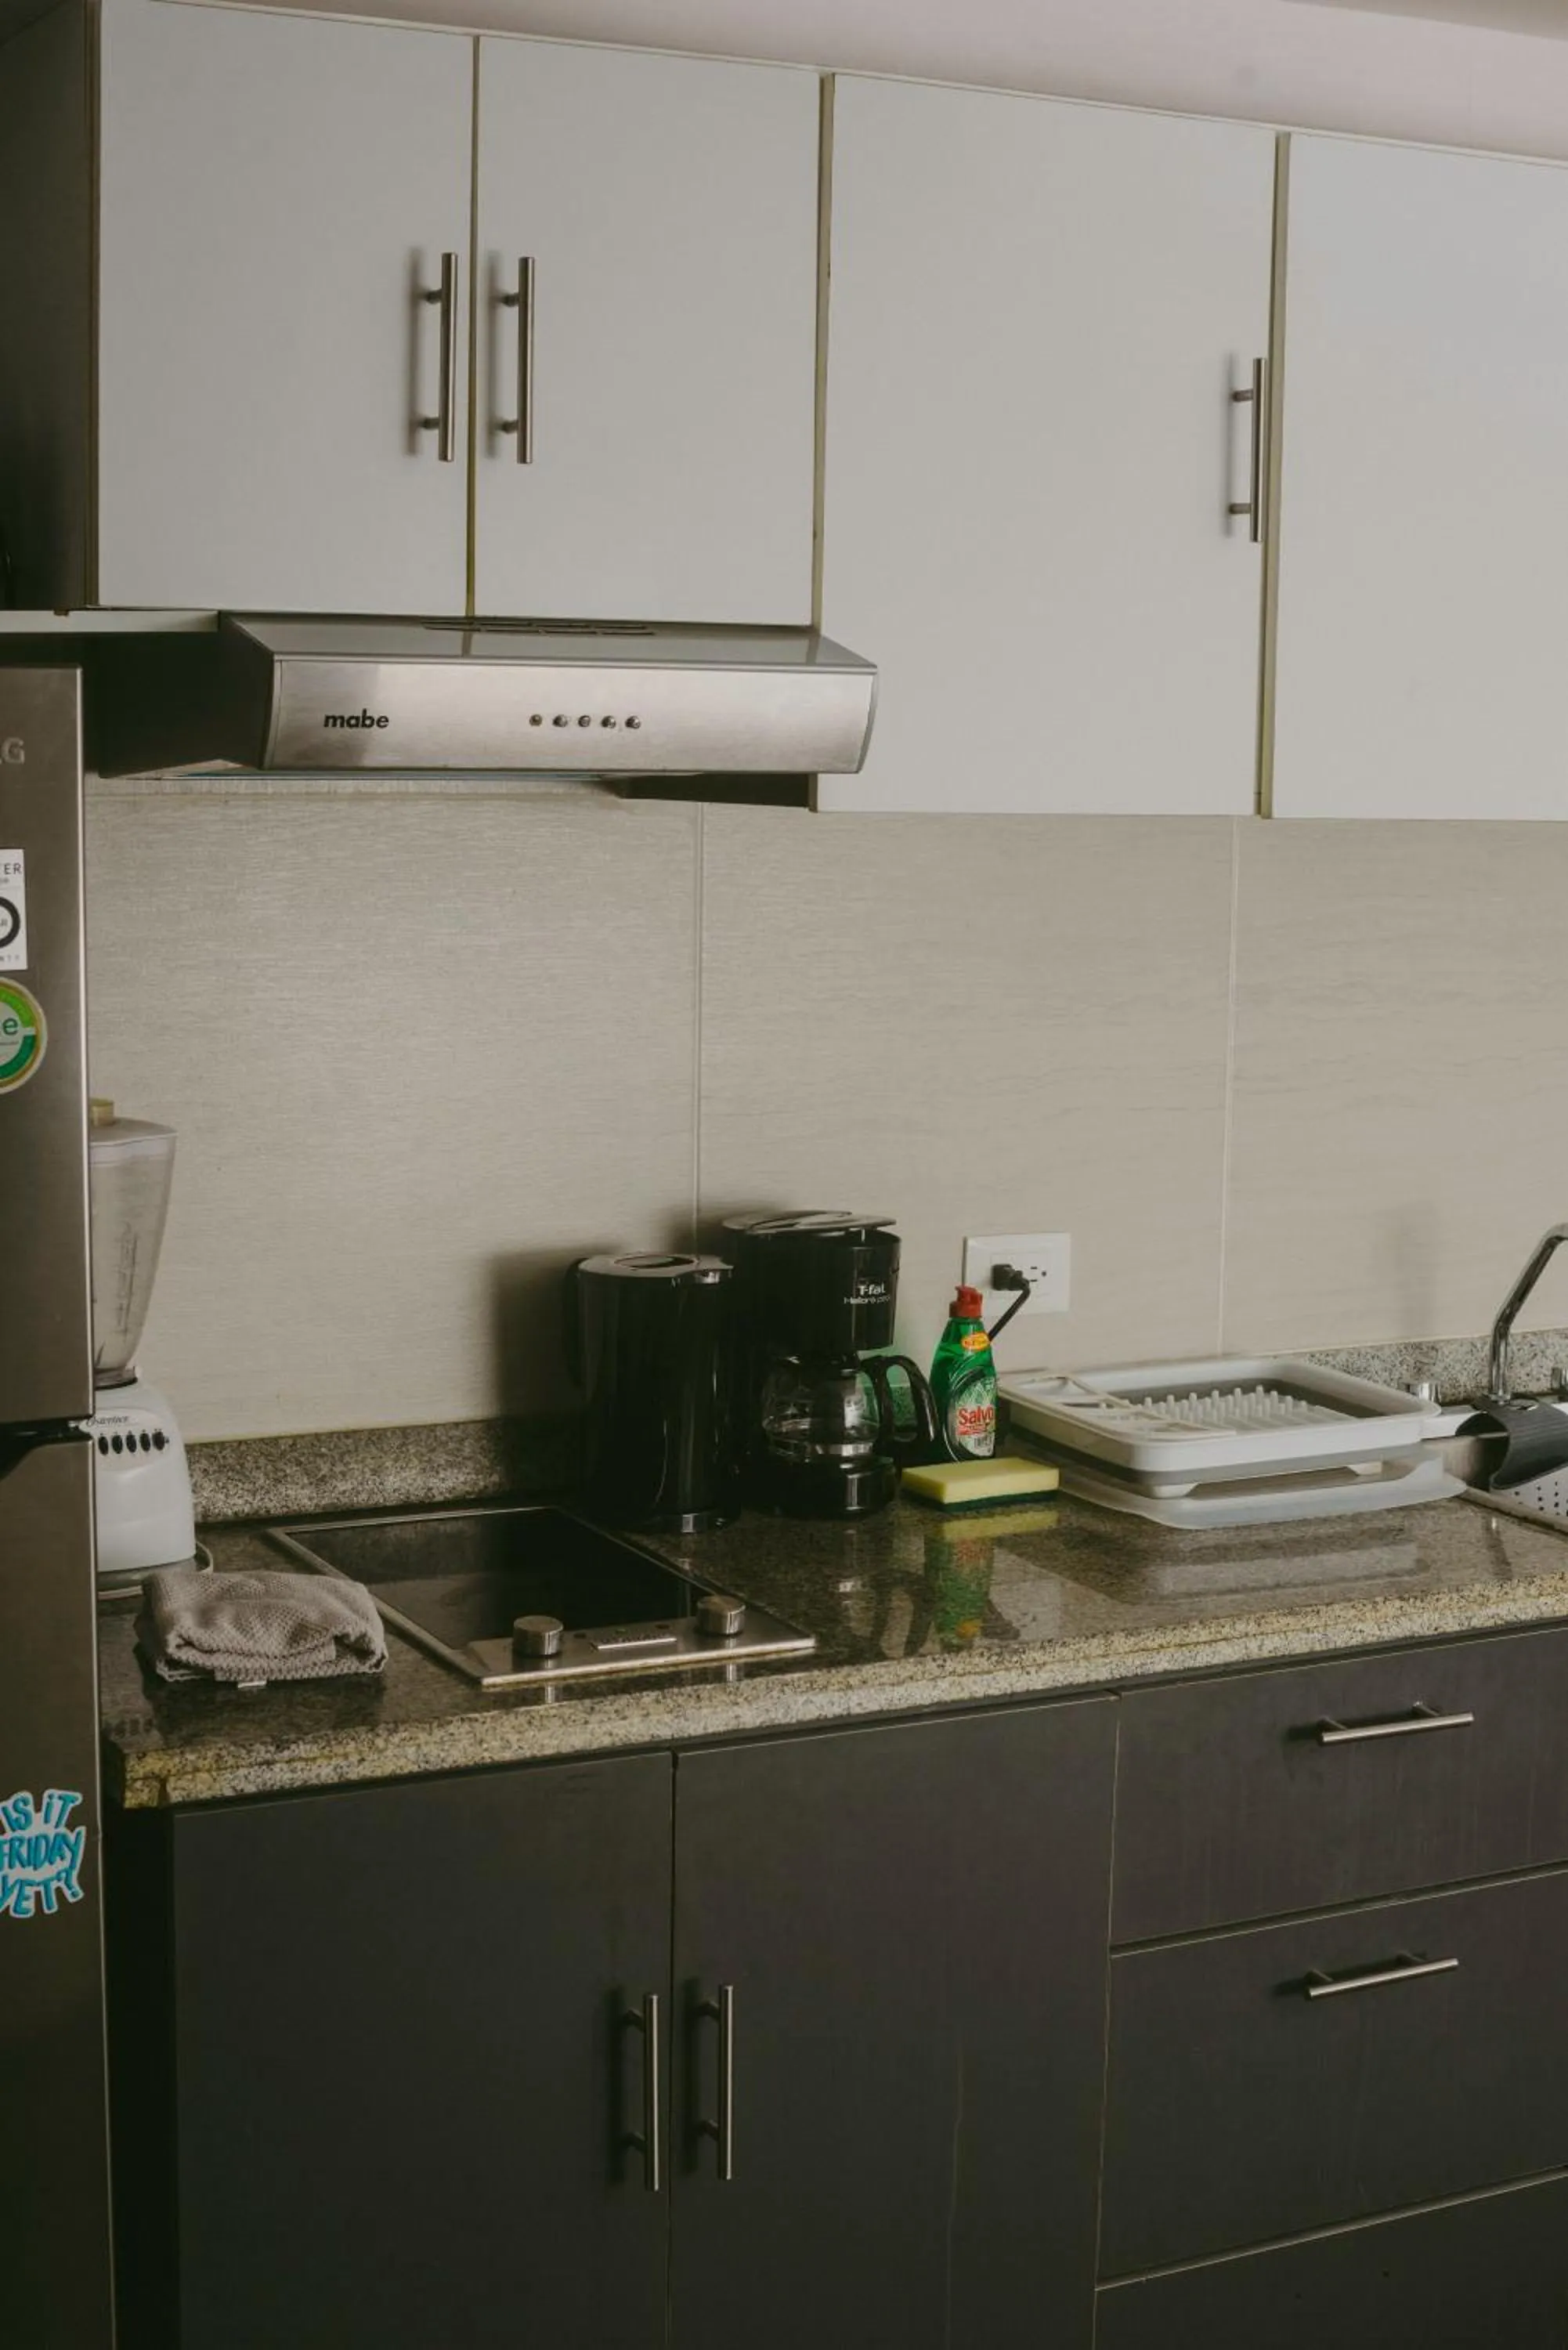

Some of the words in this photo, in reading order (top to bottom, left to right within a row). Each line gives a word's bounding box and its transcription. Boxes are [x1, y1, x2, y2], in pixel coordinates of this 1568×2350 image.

[323, 708, 389, 728] mabe
[0, 737, 25, 765] G
[4, 863, 22, 875] ER
[1, 1795, 33, 1831] IS
[0, 1831, 82, 1871] FRIDAY
